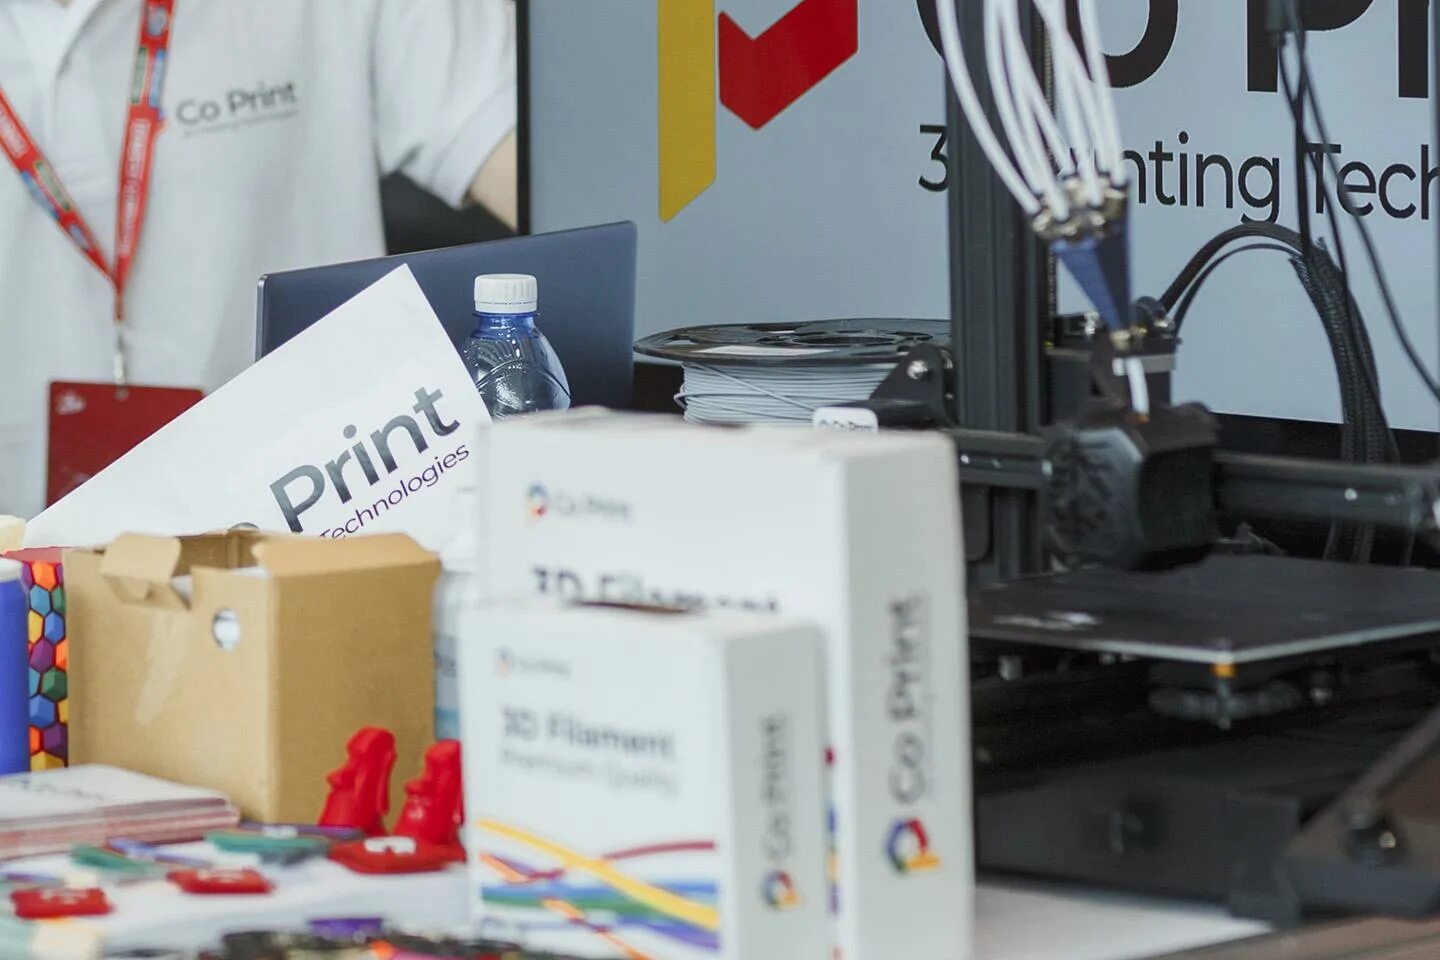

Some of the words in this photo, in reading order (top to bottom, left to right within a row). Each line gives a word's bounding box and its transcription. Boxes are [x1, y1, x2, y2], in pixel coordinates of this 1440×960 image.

[176, 98, 221, 126] Co
[225, 80, 298, 114] Print
[269, 387, 461, 534] Print
[885, 593, 930, 722] Print
[888, 732, 926, 807] Co
